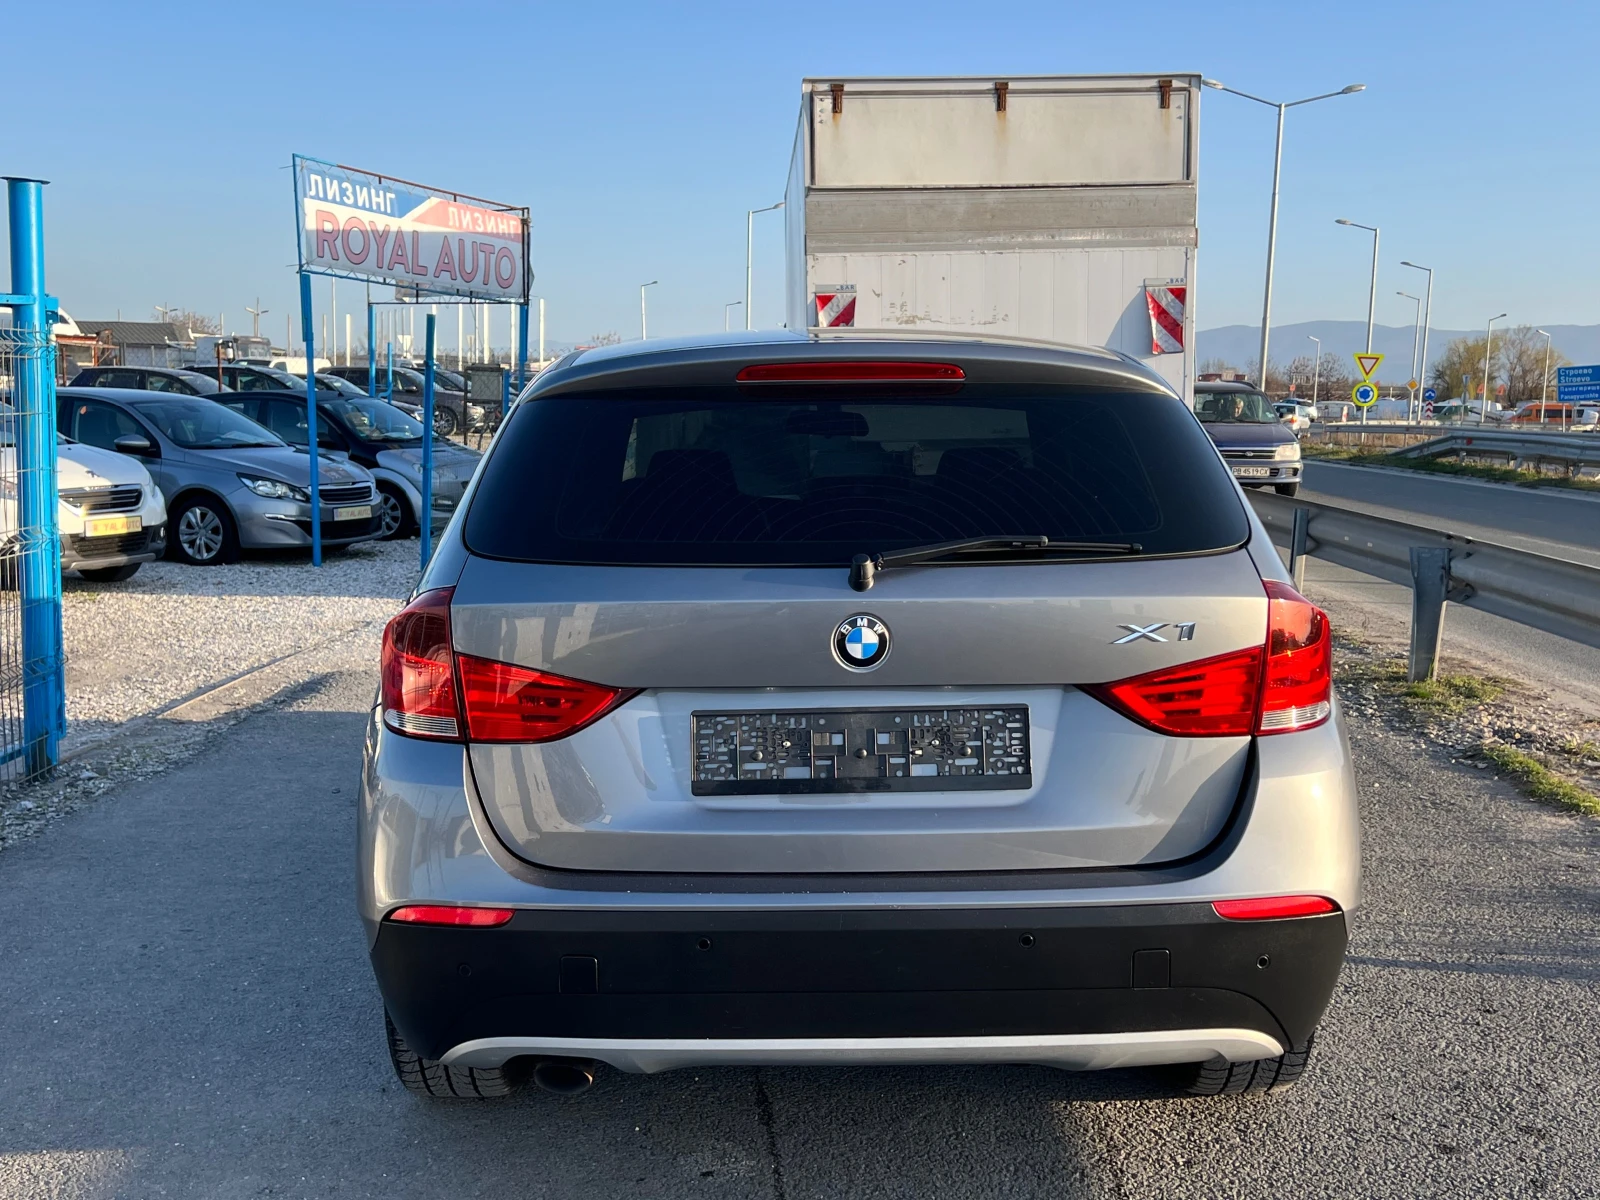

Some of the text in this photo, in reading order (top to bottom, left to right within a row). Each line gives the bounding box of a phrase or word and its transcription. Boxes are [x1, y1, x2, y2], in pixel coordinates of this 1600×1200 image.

[309, 174, 396, 213] ЛИЗИНГ
[448, 206, 517, 238] ЛИЗИНГ
[315, 209, 517, 289] ROYAL AUTO
[1560, 368, 1593, 376] Строево
[1243, 467, 1259, 475] 4519
[93, 519, 140, 532] RYAL AUTO
[840, 617, 886, 635] BMW
[1107, 621, 1197, 644] X1
